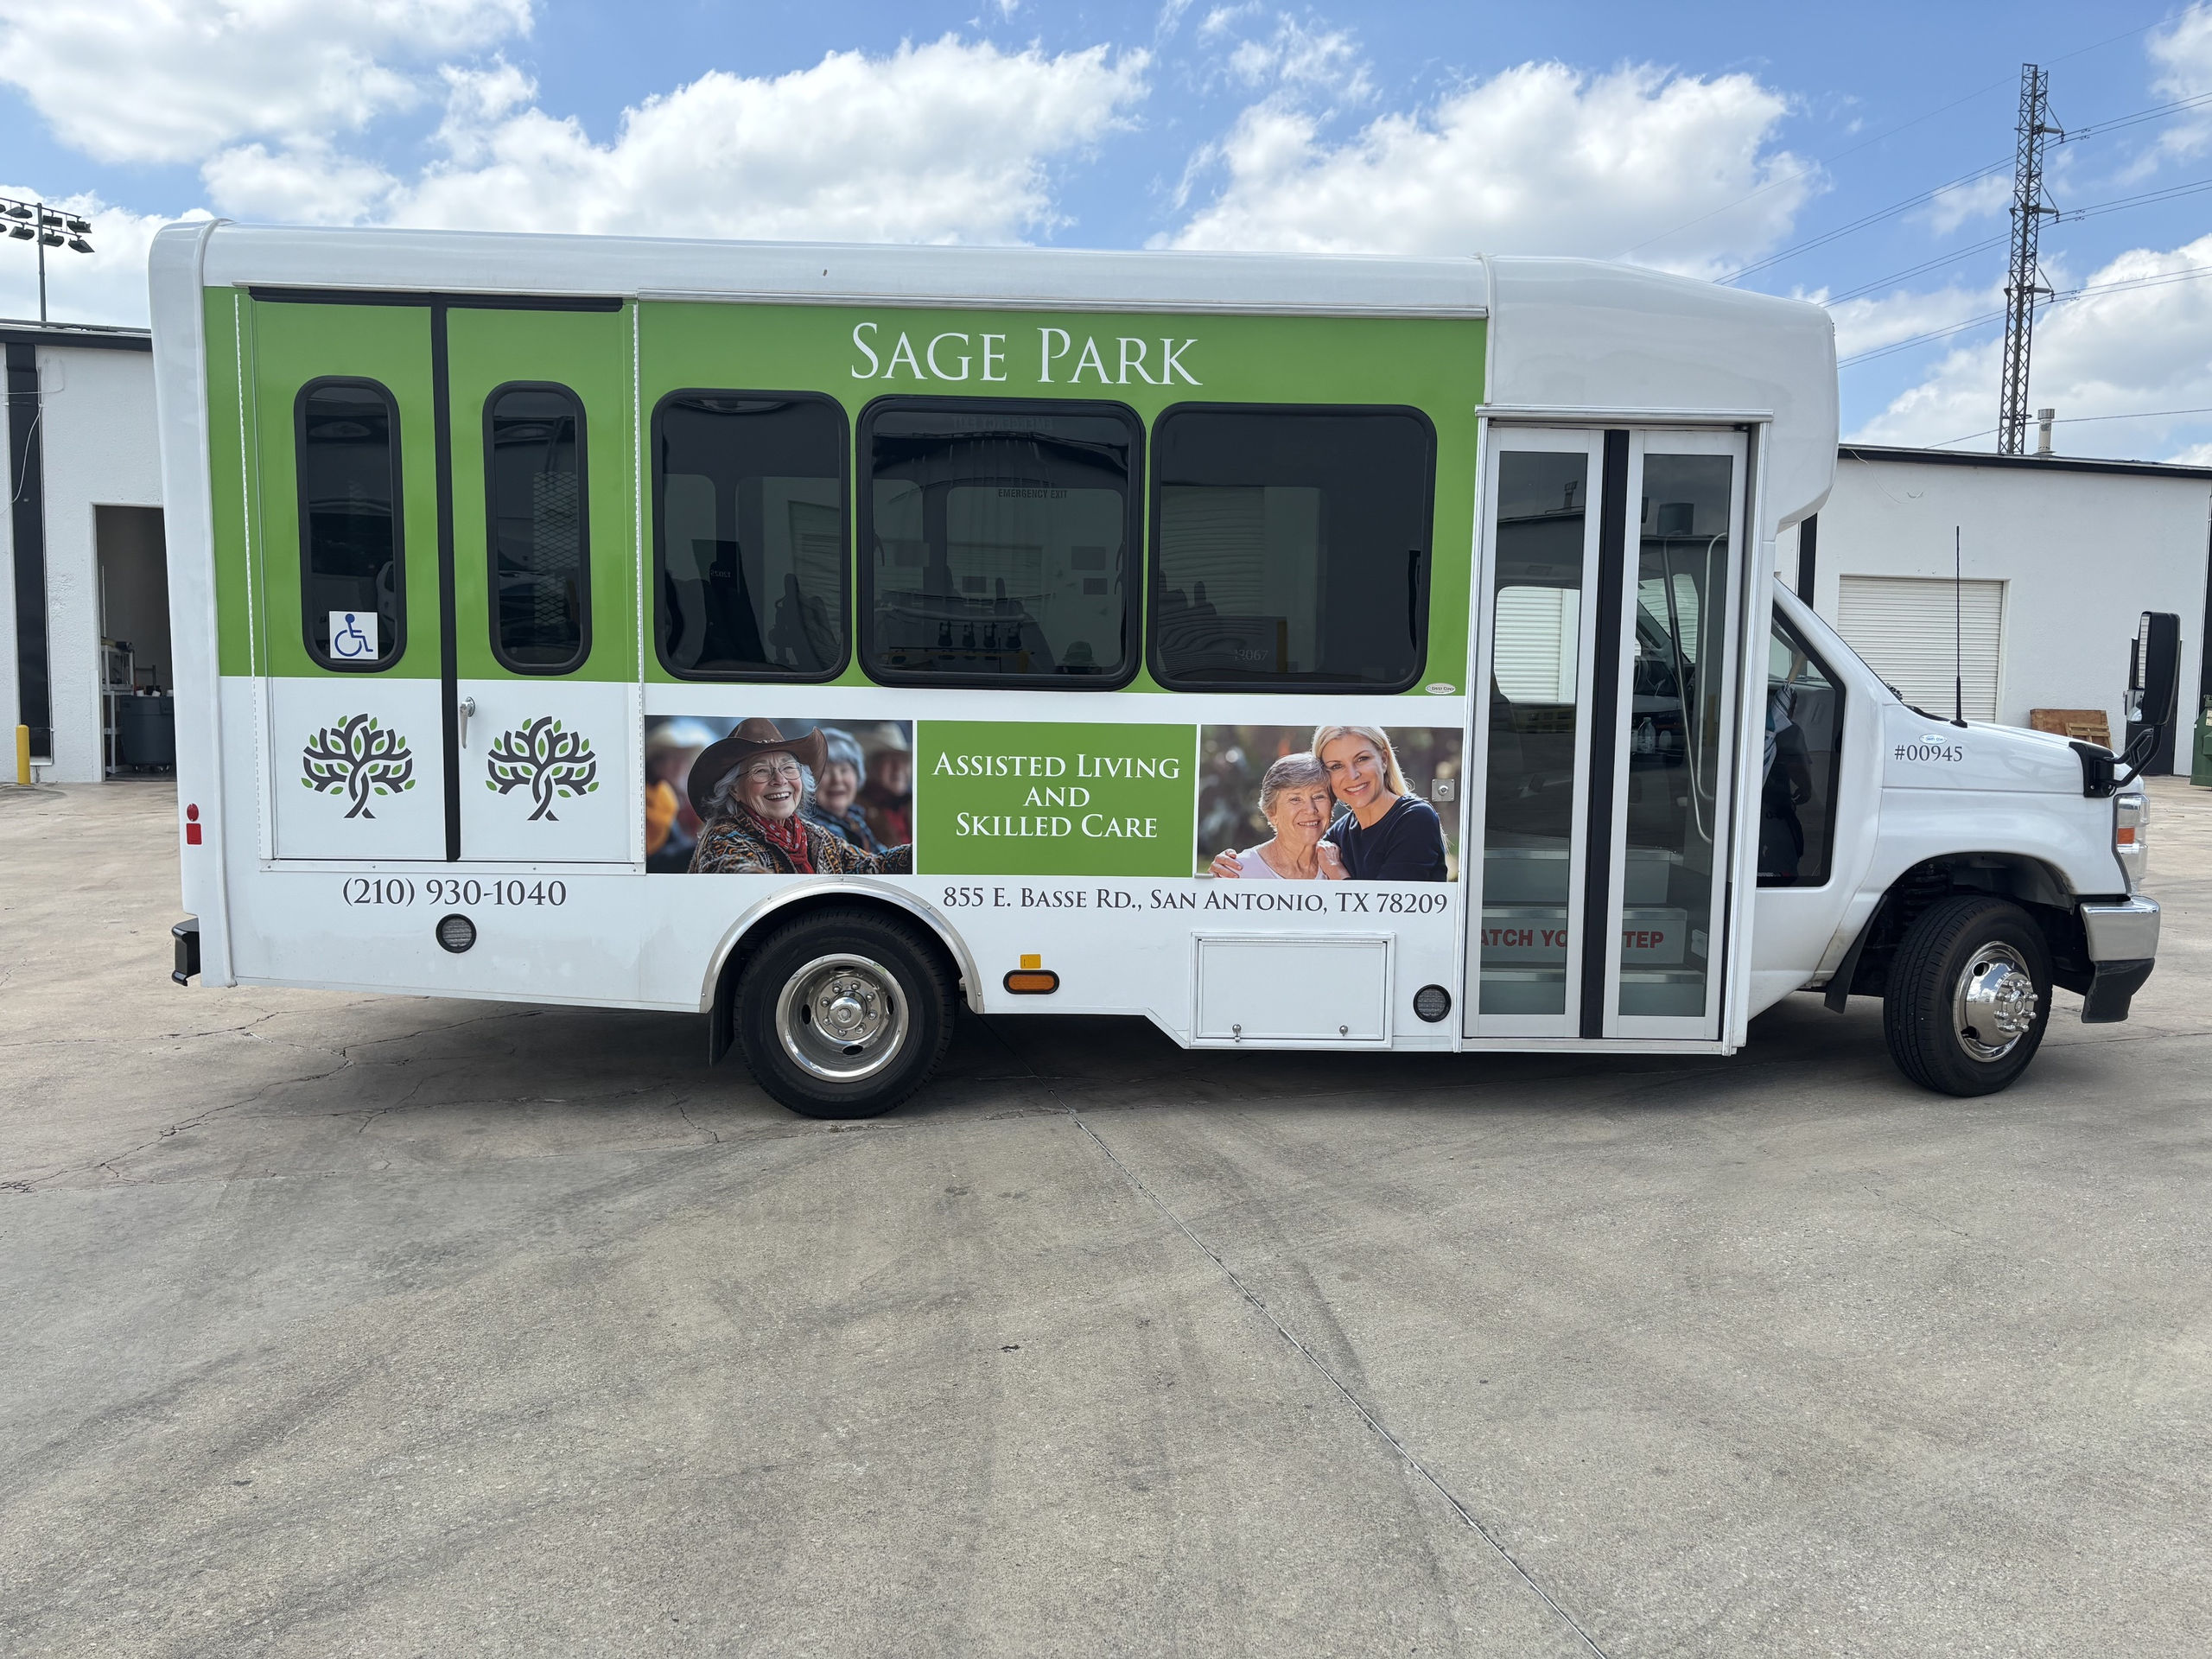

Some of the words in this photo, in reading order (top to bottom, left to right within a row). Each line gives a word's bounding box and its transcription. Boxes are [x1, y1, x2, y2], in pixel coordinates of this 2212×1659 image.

[851, 322, 1007, 381] SAGE
[1037, 327, 1203, 385] PARK
[998, 488, 1047, 499] EMERGENCY
[1051, 490, 1068, 499] EXIT
[932, 752, 1066, 778] ASSISTED
[1077, 753, 1180, 779] LIVING
[1894, 743, 1963, 762] #00945
[1022, 786, 1090, 807] AND
[956, 812, 1071, 837] SKILLED
[1081, 813, 1158, 838] CARE
[342, 877, 415, 907] (210)
[426, 879, 567, 906] 930-1040
[943, 887, 984, 907] 855
[994, 887, 1011, 907] E.
[1020, 887, 1087, 908] BASSE
[1096, 888, 1142, 912] RD.,
[1150, 889, 1197, 910] SAN
[1203, 890, 1328, 915] ANTONIO,
[1335, 892, 1370, 912] TX
[1376, 893, 1448, 914] 78209
[1481, 929, 1533, 947] ATCH
[1541, 930, 1567, 947] YO
[1623, 931, 1664, 949] TEP
